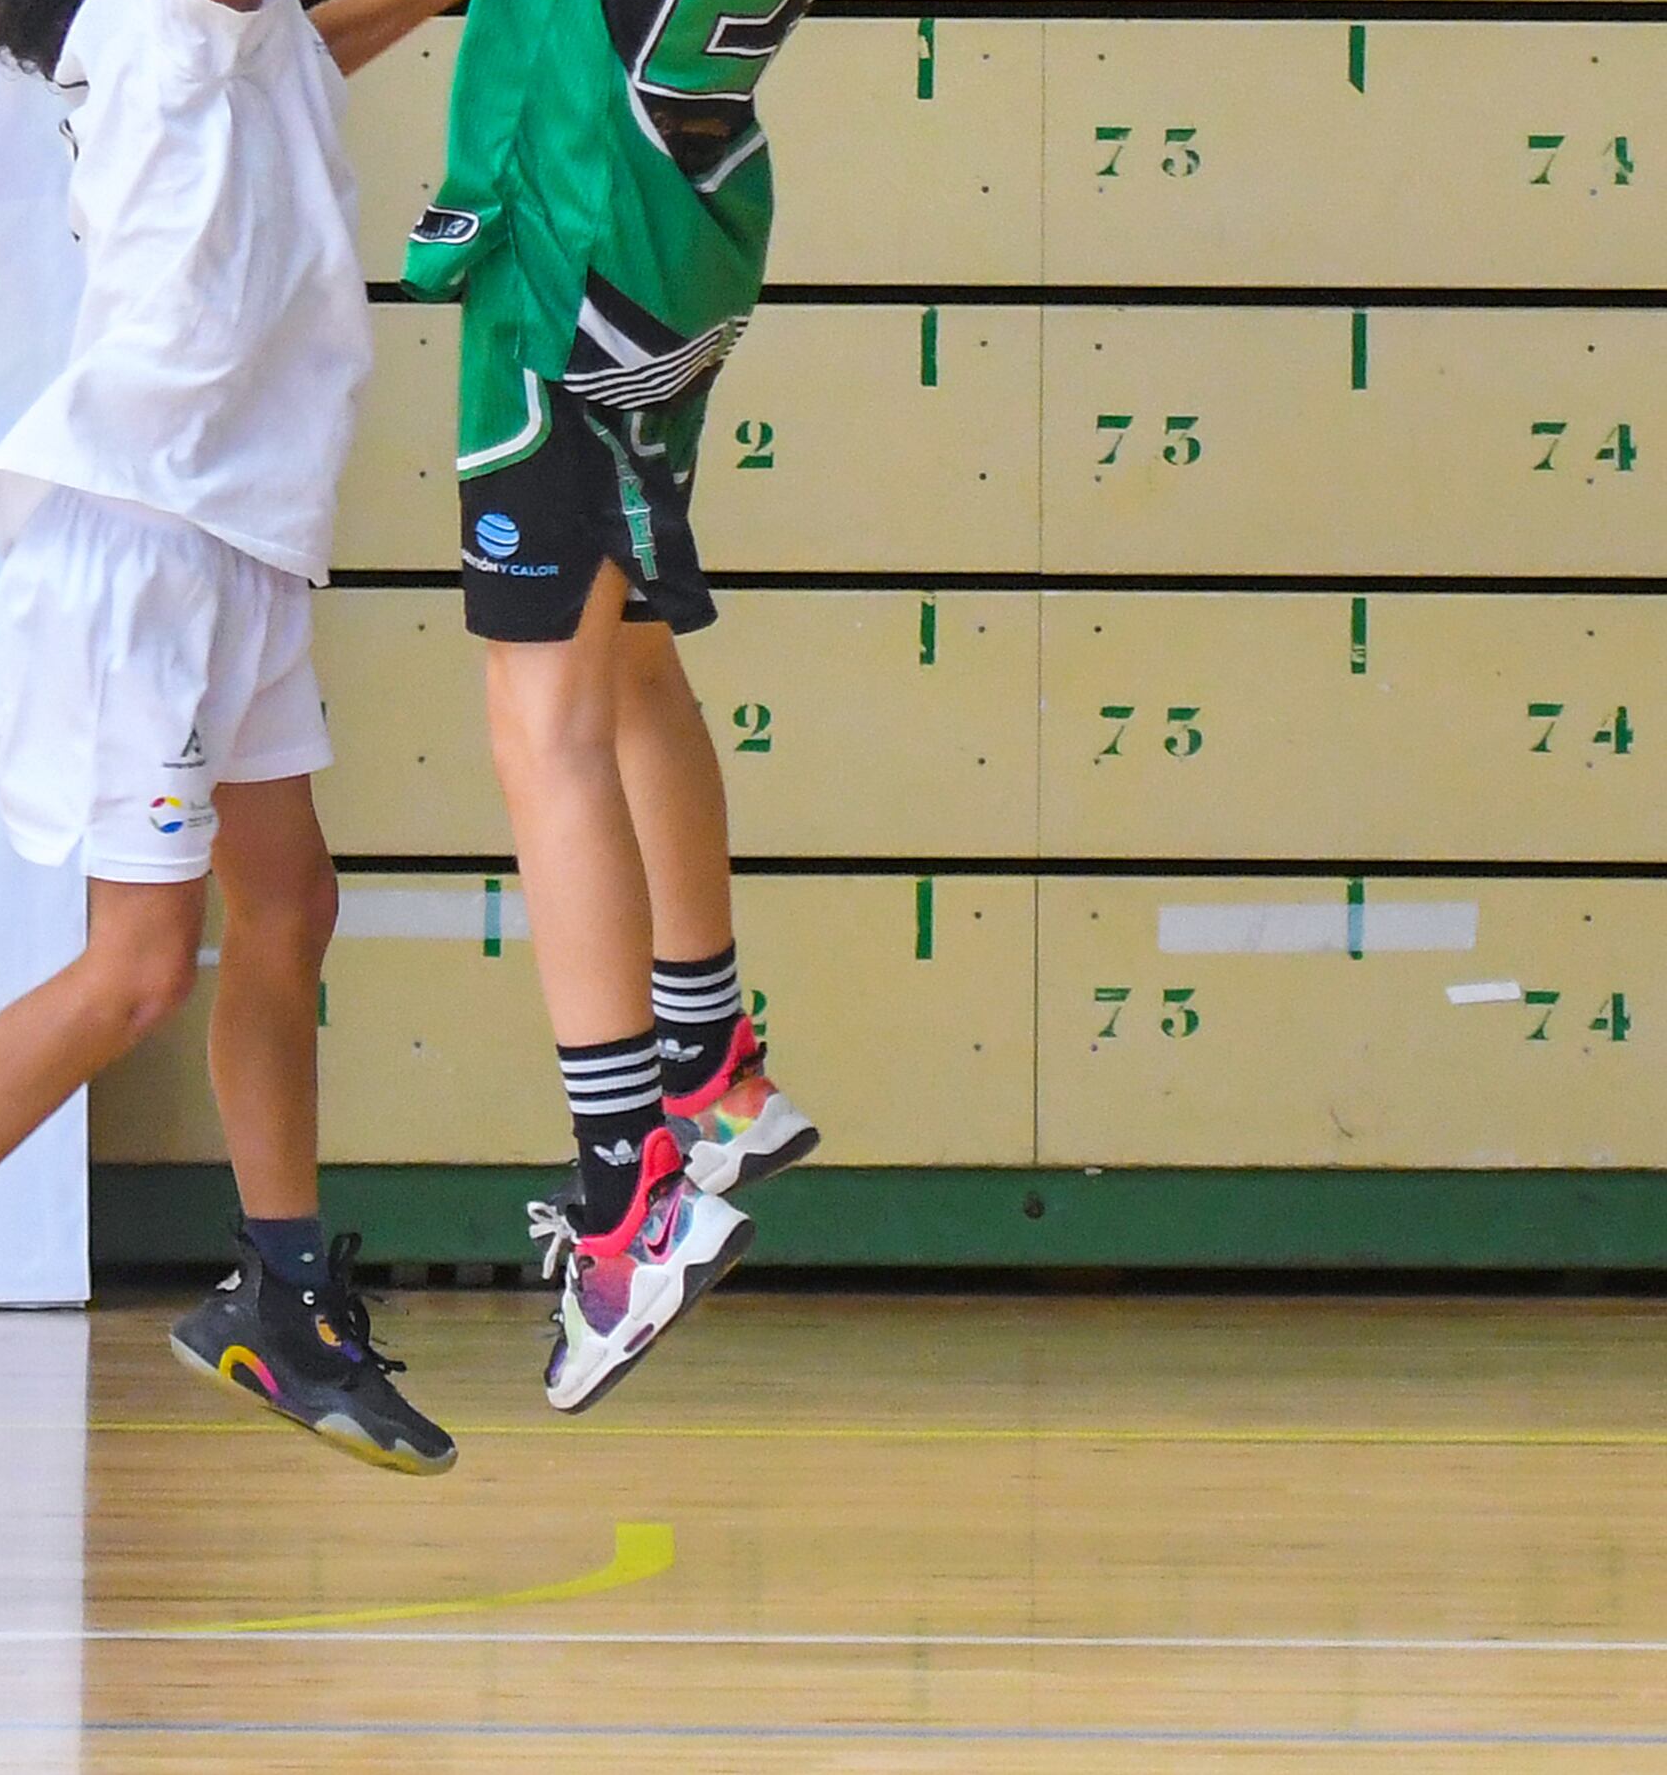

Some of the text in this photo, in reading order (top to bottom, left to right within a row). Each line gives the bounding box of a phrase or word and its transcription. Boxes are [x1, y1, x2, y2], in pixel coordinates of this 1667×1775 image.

[1533, 421, 1638, 473] 74
[1528, 701, 1636, 755] 74
[1525, 989, 1632, 1043] 74
